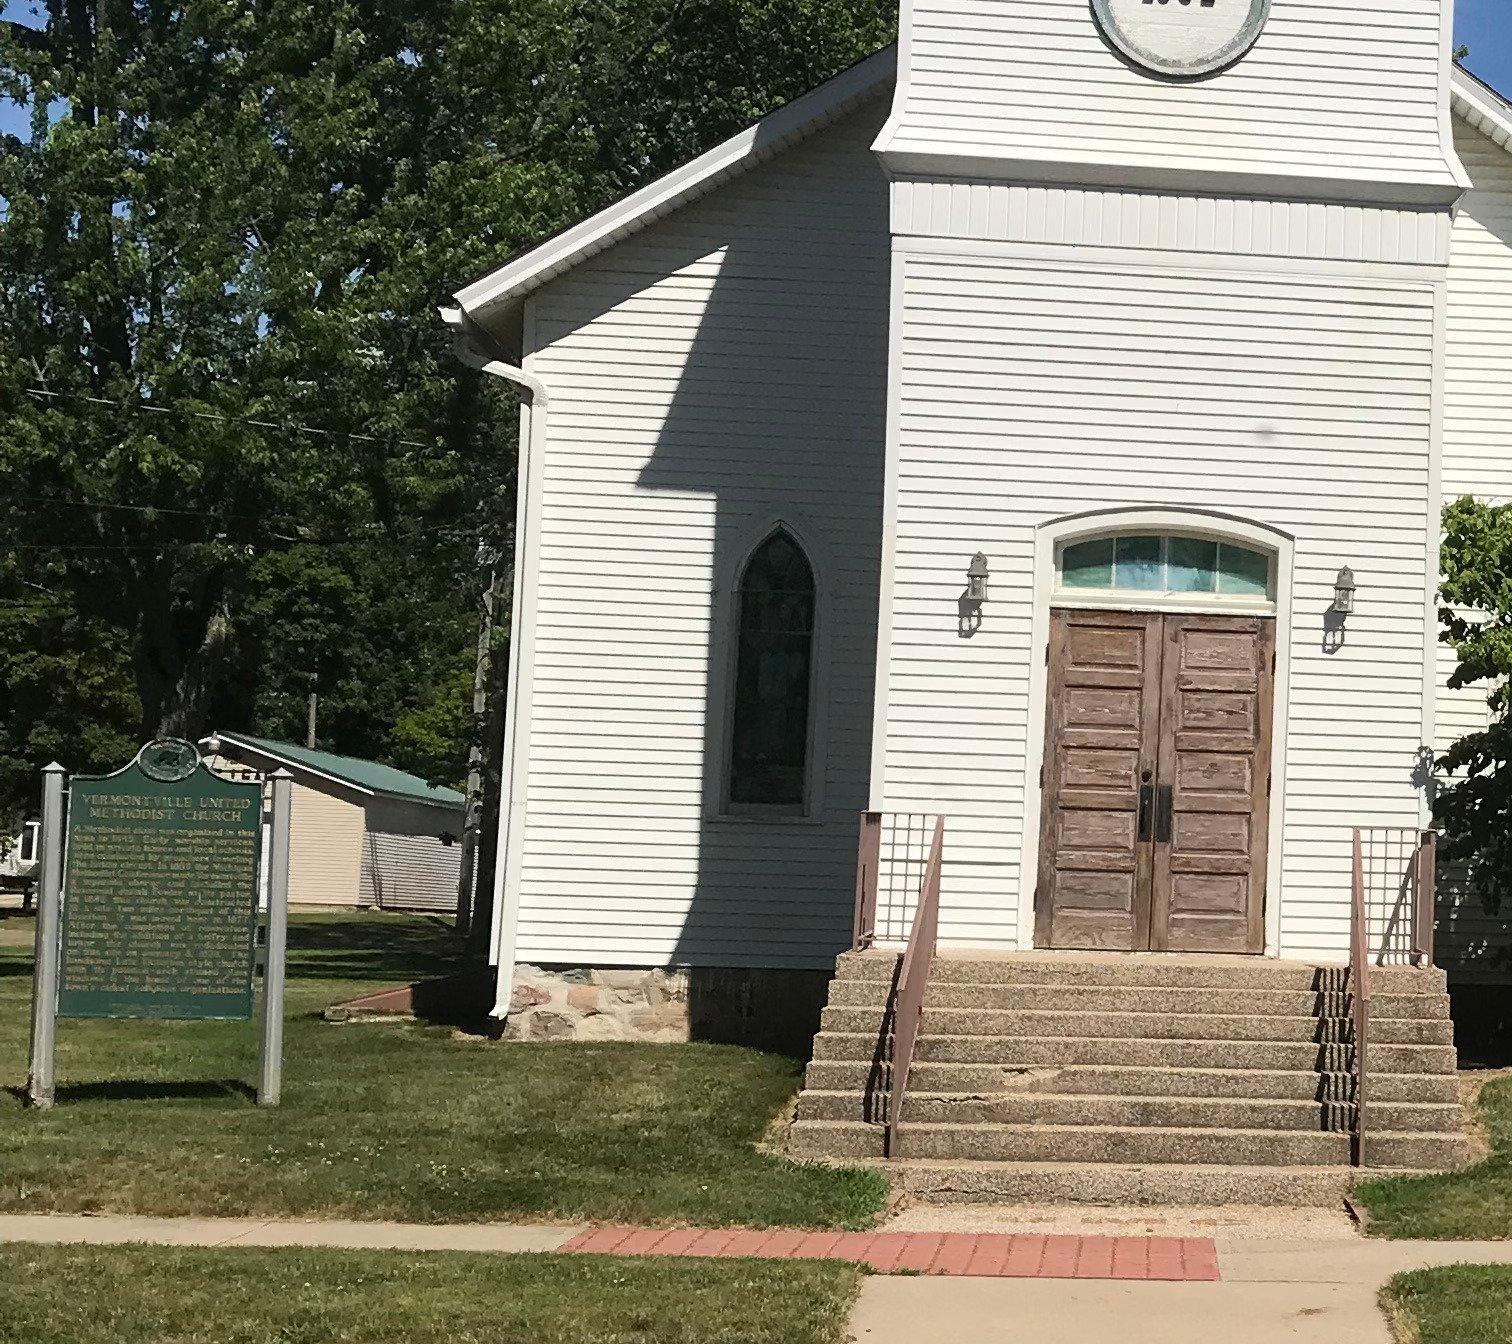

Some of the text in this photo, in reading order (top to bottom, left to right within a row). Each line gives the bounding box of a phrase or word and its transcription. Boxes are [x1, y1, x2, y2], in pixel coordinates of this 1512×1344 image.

[82, 794, 251, 810] VERMONTVILLE UNITED
[89, 807, 242, 822] METHODIST CHURCH
